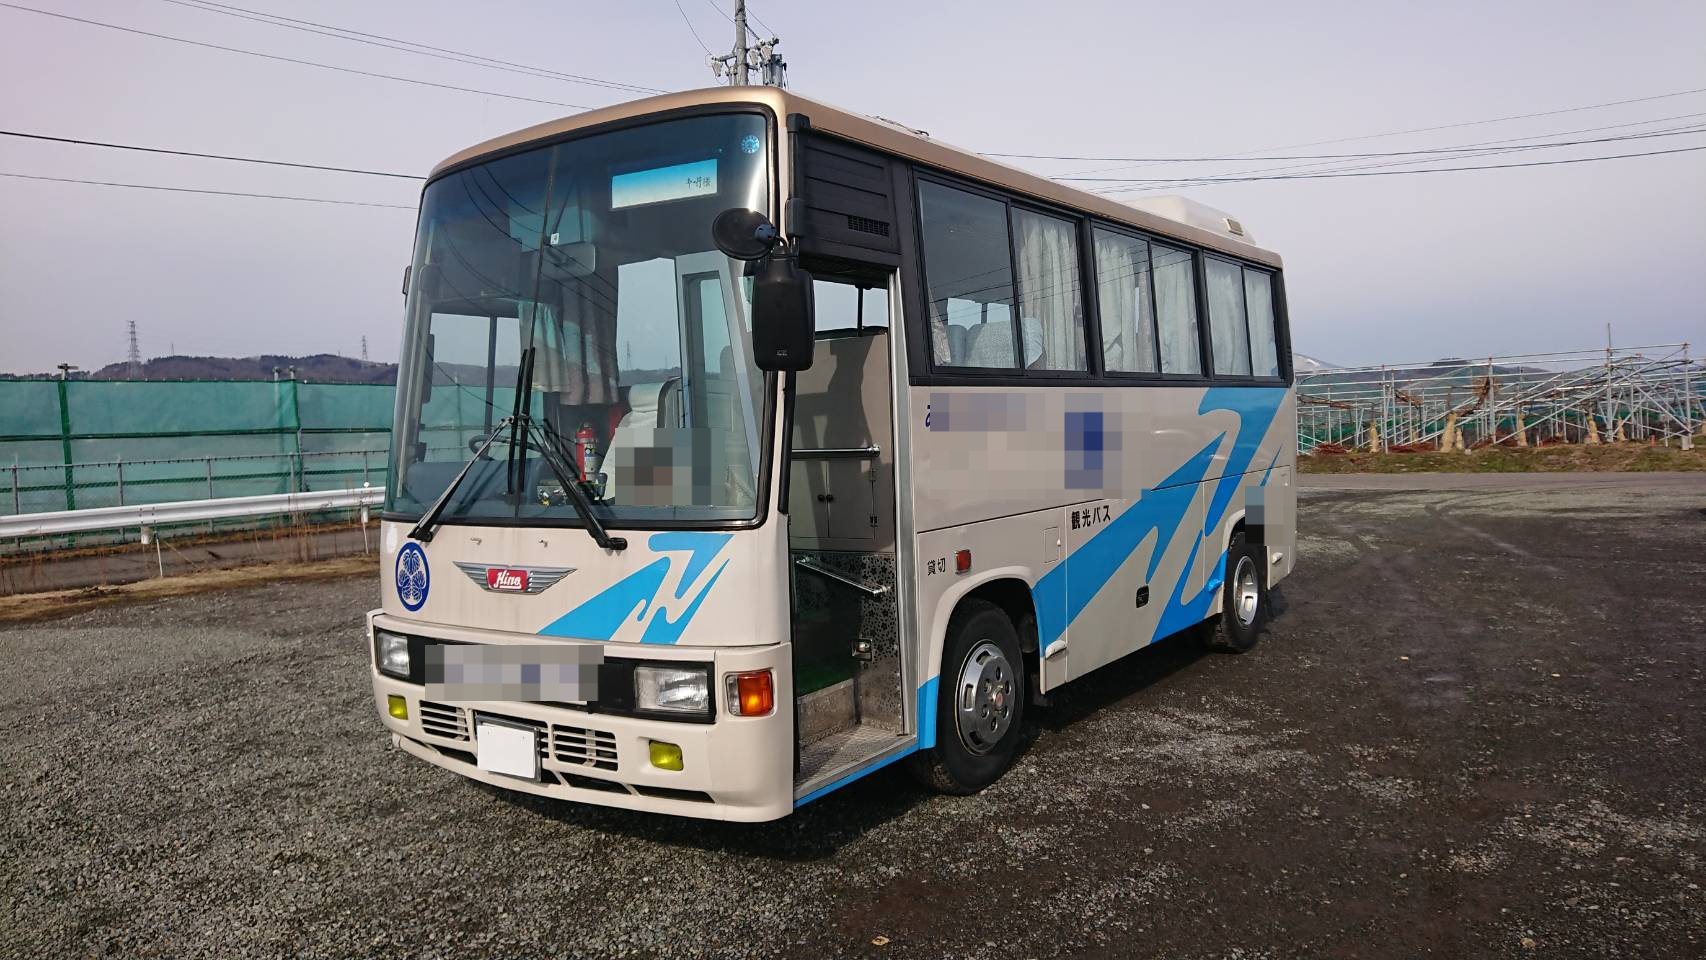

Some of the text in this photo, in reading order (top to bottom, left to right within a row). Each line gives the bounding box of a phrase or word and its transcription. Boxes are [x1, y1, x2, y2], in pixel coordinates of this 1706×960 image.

[1071, 504, 1111, 530] 観光バス
[927, 557, 946, 576] 貸切
[493, 569, 522, 589] Hino
